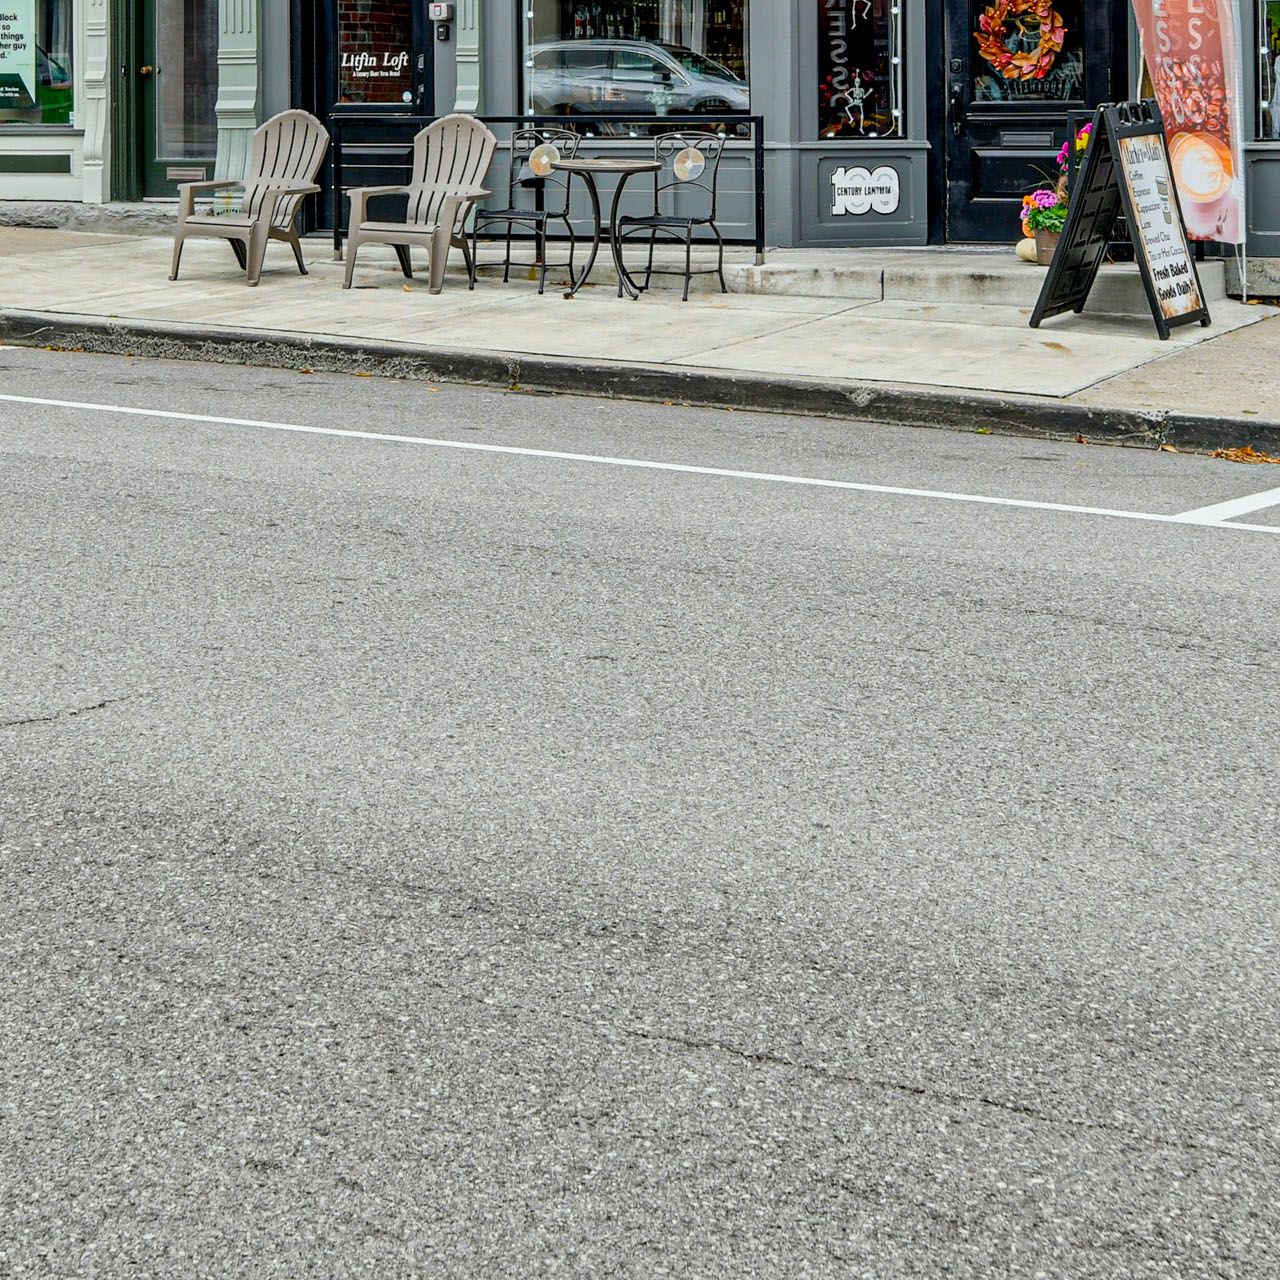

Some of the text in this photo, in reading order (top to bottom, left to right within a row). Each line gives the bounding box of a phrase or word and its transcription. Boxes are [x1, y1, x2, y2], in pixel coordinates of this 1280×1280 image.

[1, 33, 24, 41] things
[341, 51, 409, 71] Litfin Loft
[1129, 170, 1144, 181] Coffee
[837, 187, 862, 196] CENTURY
[1132, 187, 1151, 198] Espresso
[1152, 260, 1189, 281] Fresh Baked
[1158, 285, 1177, 301] Goods
